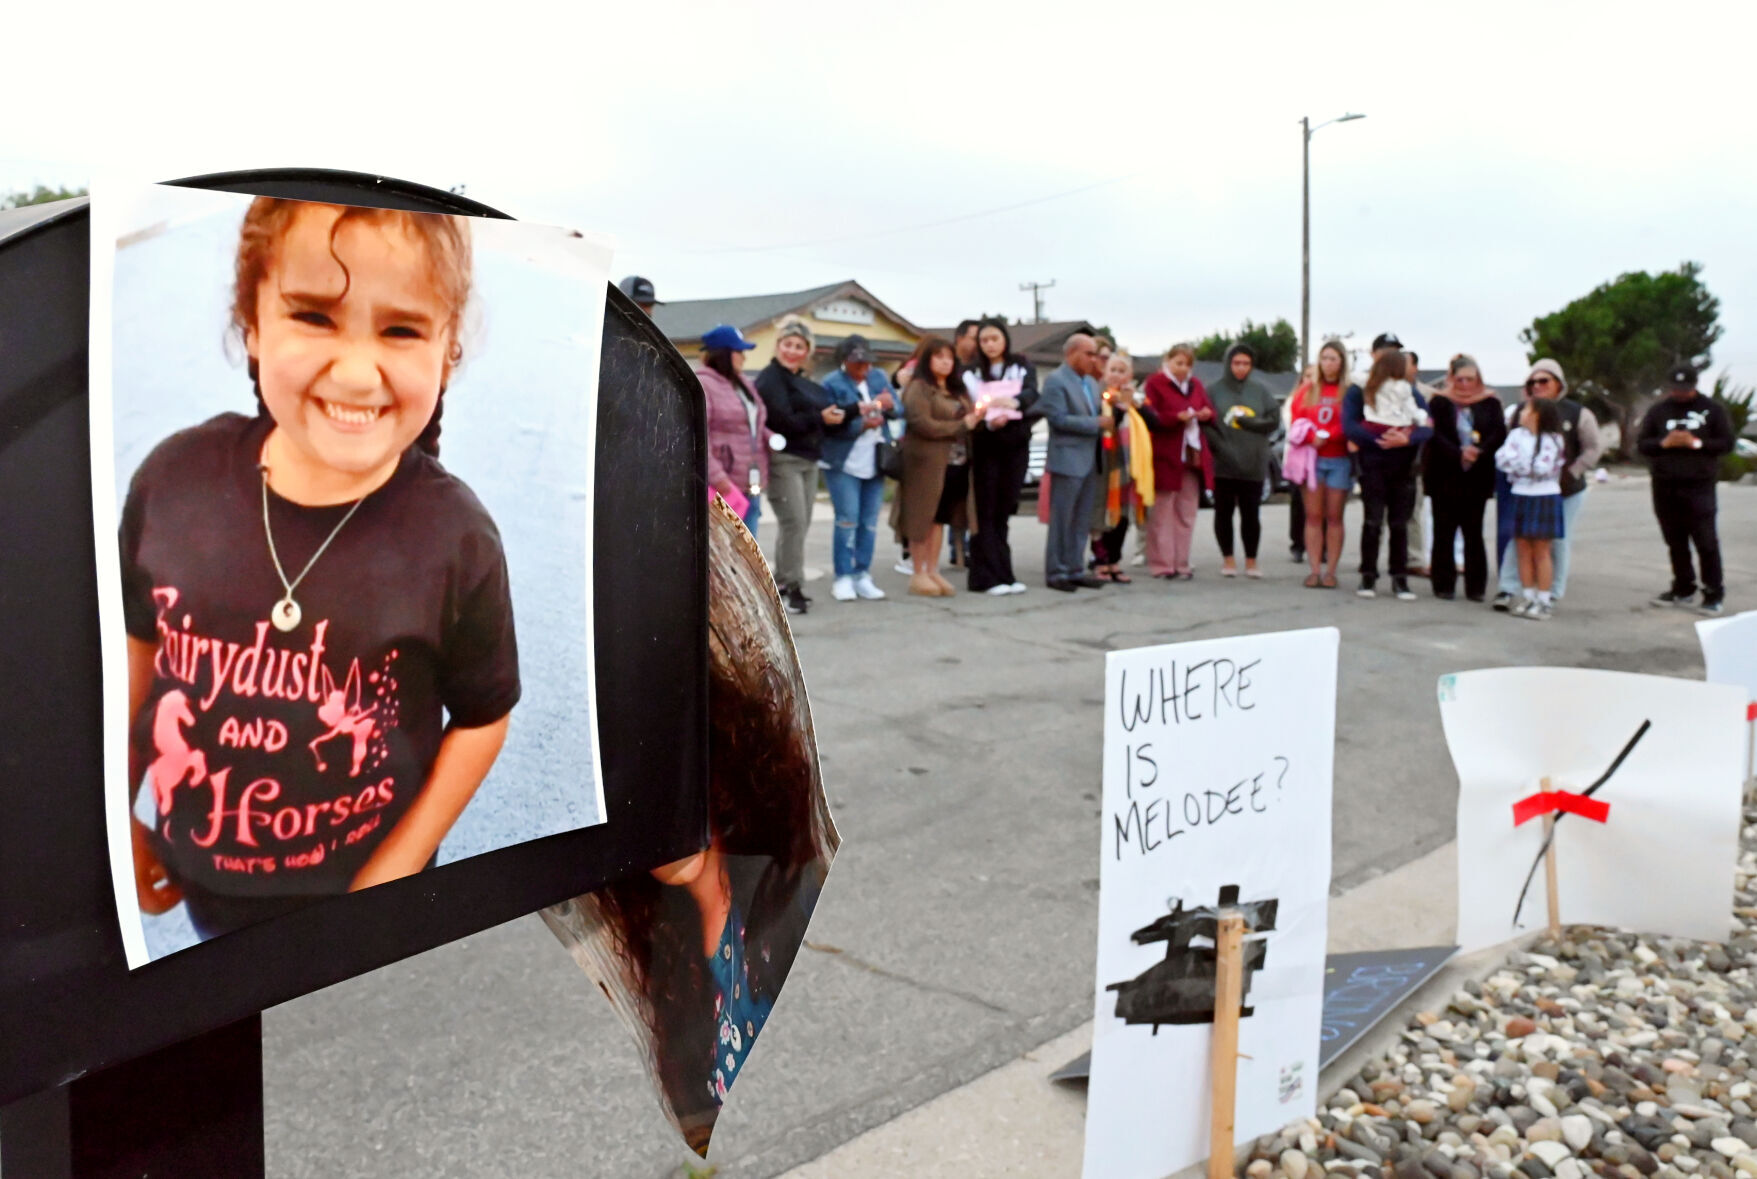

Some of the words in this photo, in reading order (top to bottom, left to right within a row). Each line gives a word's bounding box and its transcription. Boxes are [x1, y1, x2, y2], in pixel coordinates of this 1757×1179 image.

[1121, 658, 1262, 732] WHERE
[218, 716, 289, 752] AND
[190, 766, 395, 848] Horses
[1114, 755, 1289, 861] MELODEE?
[1126, 743, 1158, 800] IS
